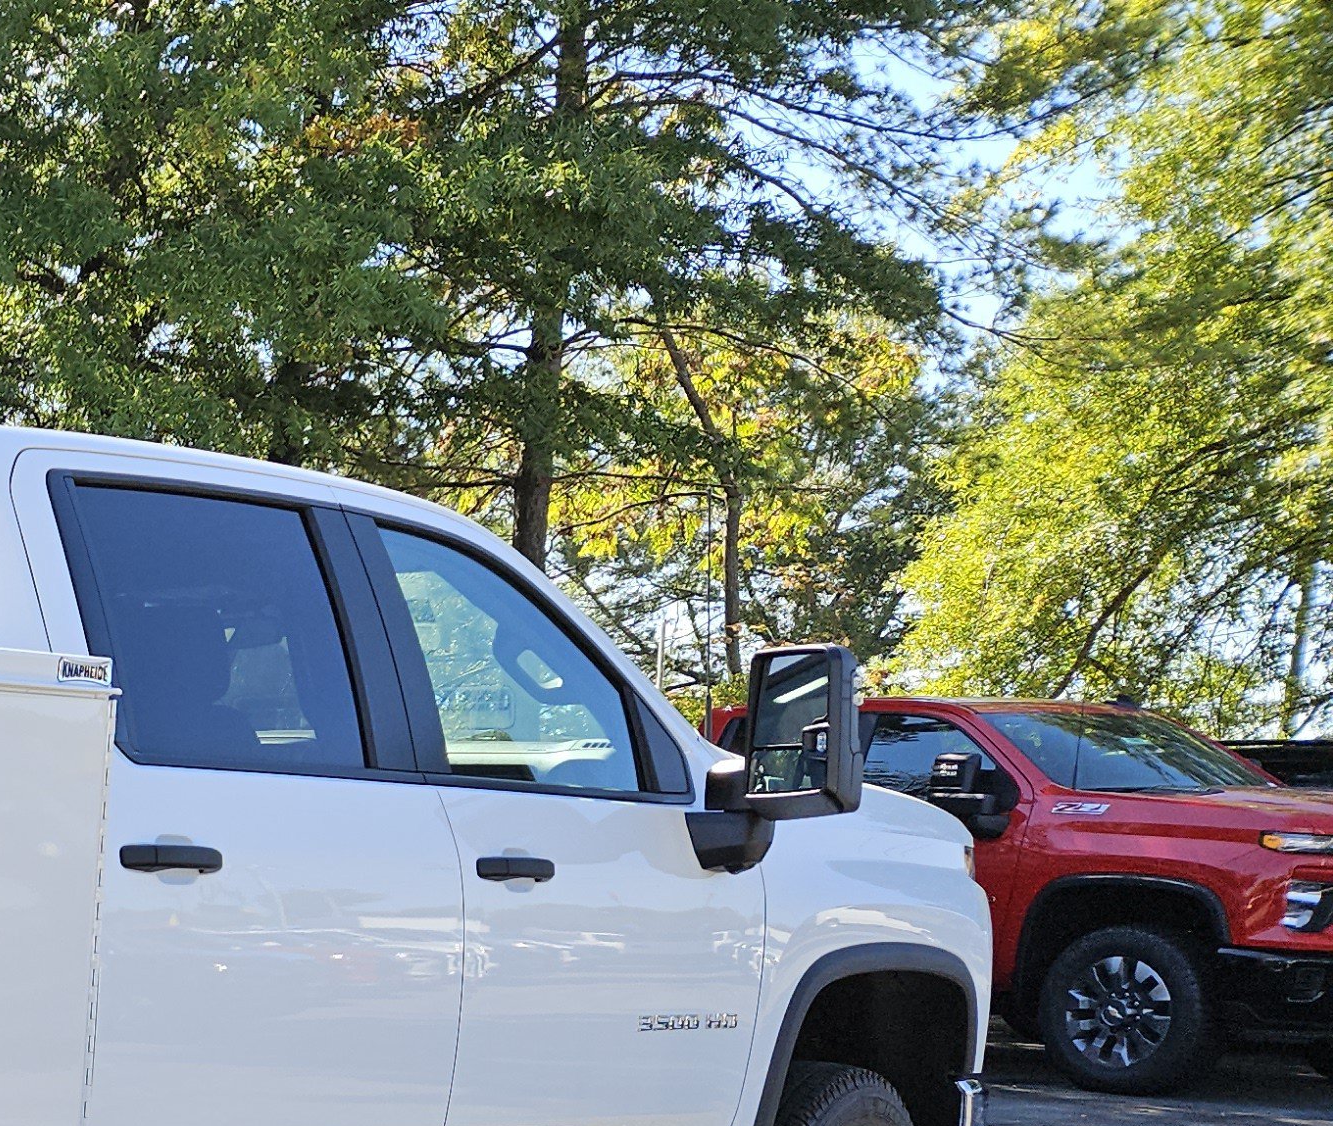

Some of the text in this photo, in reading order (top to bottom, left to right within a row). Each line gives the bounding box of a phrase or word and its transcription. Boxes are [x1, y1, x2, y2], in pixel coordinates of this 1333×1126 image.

[62, 661, 109, 682] KNAPHEIDE
[638, 1012, 738, 1032] 3500 HD
